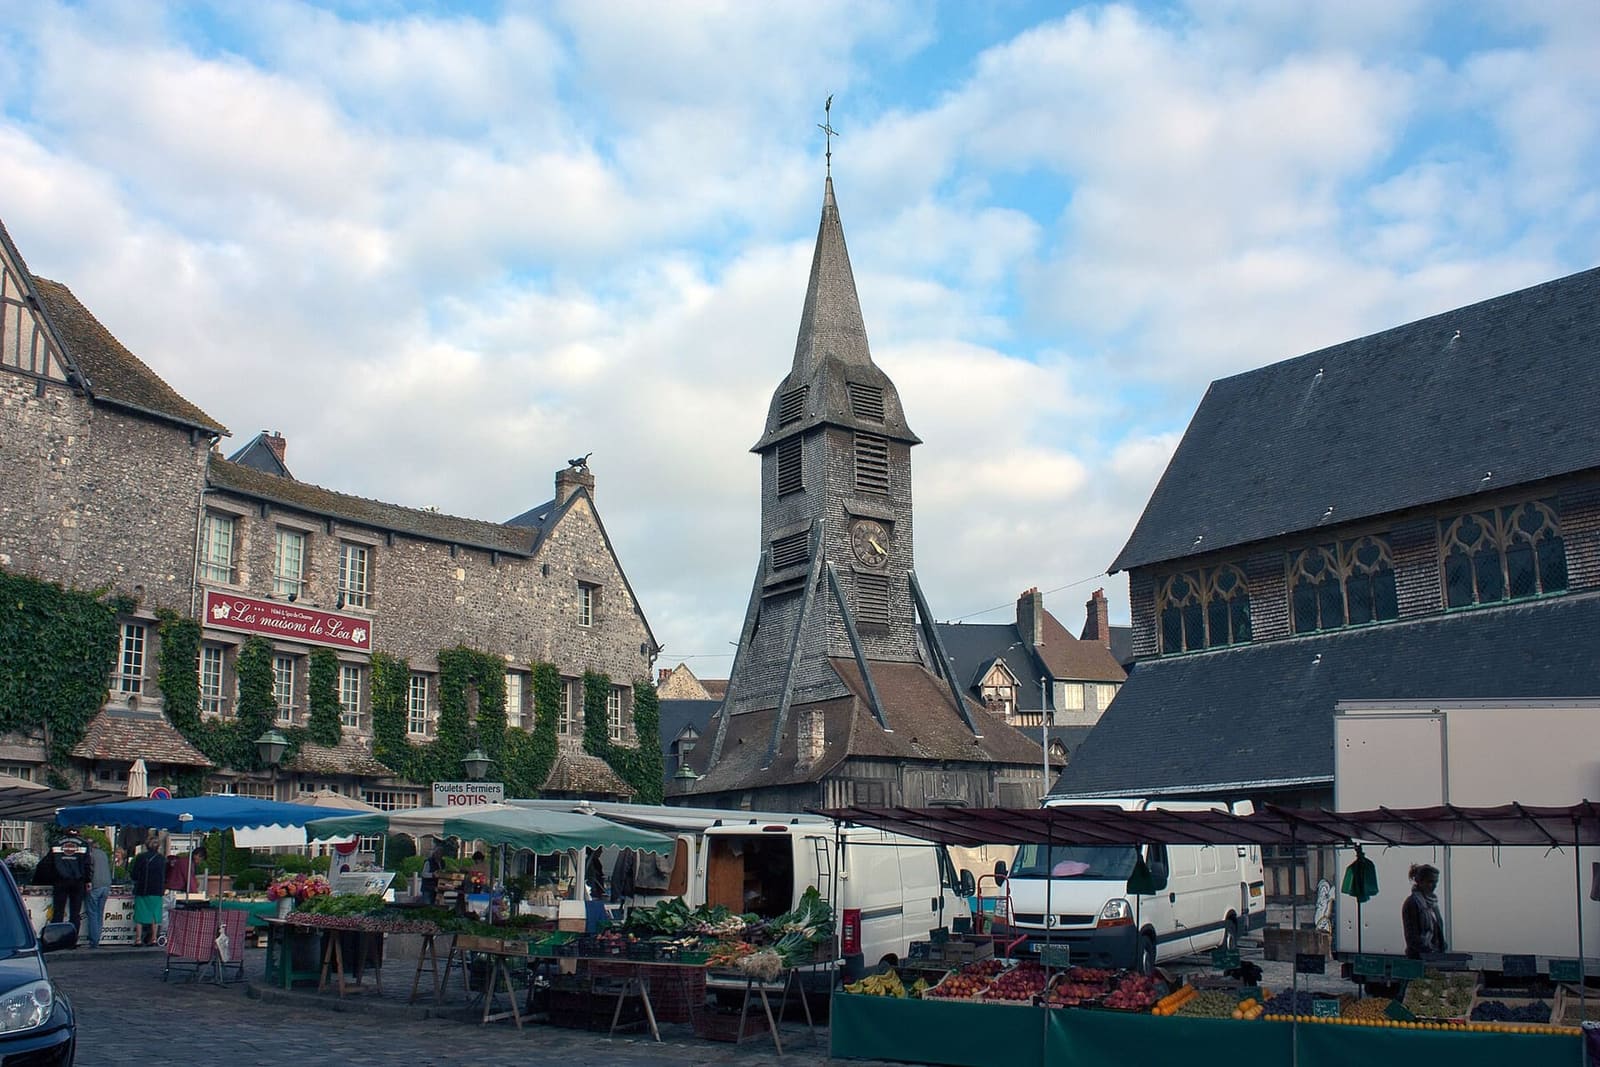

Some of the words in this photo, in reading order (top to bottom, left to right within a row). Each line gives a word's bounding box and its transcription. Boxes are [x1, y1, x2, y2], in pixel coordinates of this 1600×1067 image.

[231, 601, 255, 623] Les
[259, 616, 306, 633] maisons
[309, 619, 323, 635] de
[324, 617, 350, 640] Léa
[434, 784, 463, 793] Poulets
[466, 784, 501, 793] Fermiers
[447, 794, 487, 806] ROTIS
[104, 912, 123, 921] Pain
[126, 912, 135, 921] d'
